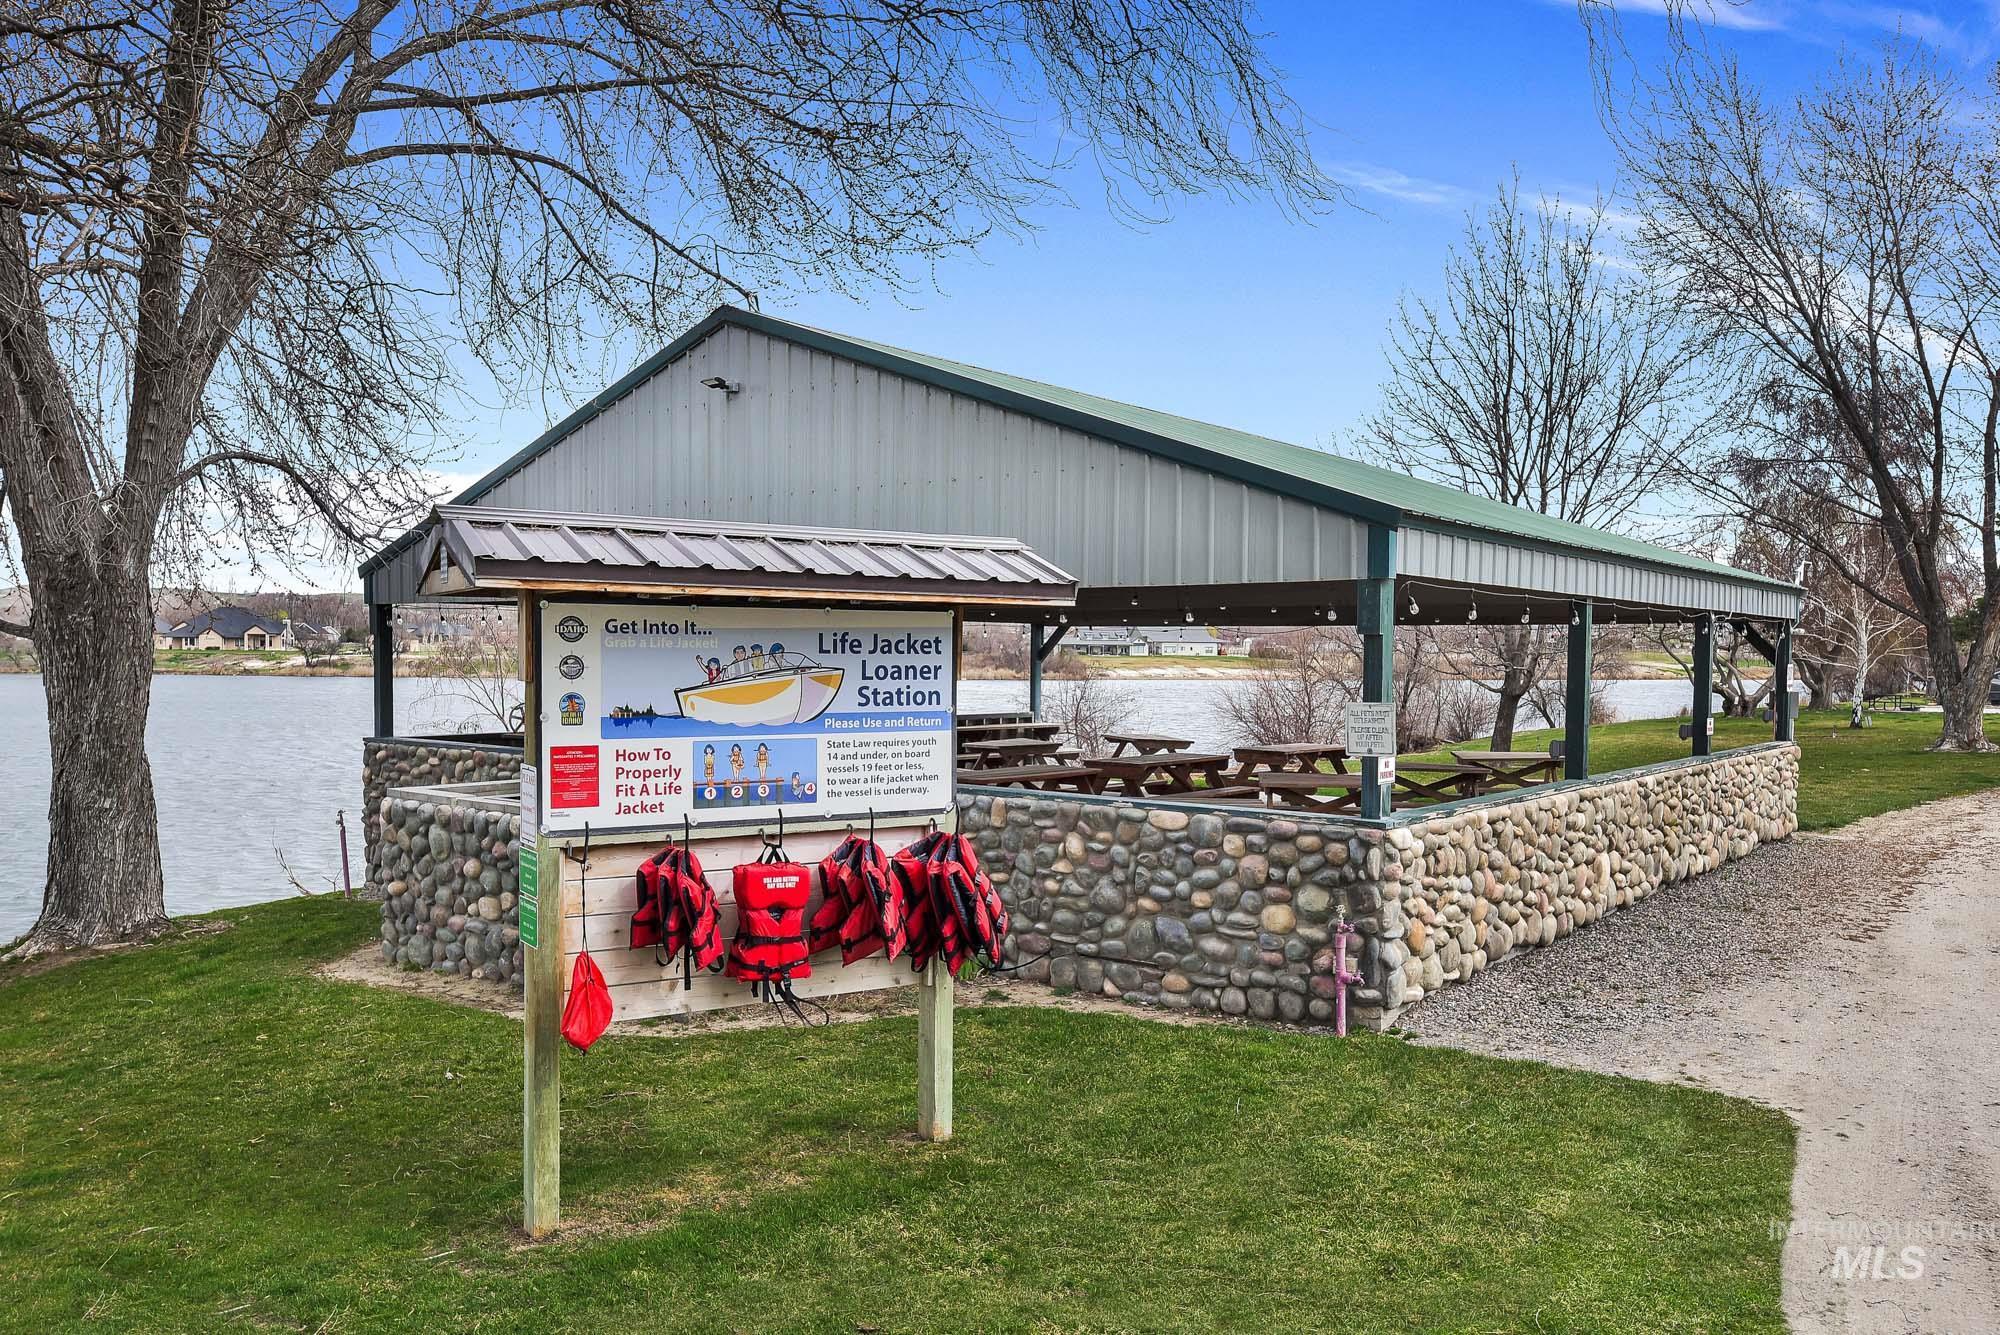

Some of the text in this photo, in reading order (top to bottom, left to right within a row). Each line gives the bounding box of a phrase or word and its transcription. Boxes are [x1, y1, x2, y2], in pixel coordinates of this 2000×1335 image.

[556, 625, 588, 633] IDAHO
[605, 618, 713, 636] Get Into It...
[605, 637, 718, 649] Grab a Life Jacket!
[818, 631, 942, 655] Life Jacket
[861, 660, 942, 680] Loaner
[857, 685, 941, 707] Station
[824, 716, 942, 729] Please Use and Return
[826, 737, 937, 749] State Law requires youth
[615, 748, 671, 762] How To
[827, 752, 838, 761] 14
[840, 752, 858, 760] and
[860, 751, 889, 760] under,
[904, 749, 931, 758] board
[615, 764, 682, 782] Properly
[826, 762, 924, 773] vessels 19 feet or less,
[827, 778, 837, 786] to
[839, 777, 860, 785] wear
[870, 775, 885, 784] life
[886, 774, 913, 785] jacket
[915, 773, 939, 782] when
[615, 781, 682, 797] Fit A Life
[707, 784, 813, 797] 1 2 3 4
[827, 786, 929, 798] the vessel is underway.
[615, 800, 664, 815] Jacket
